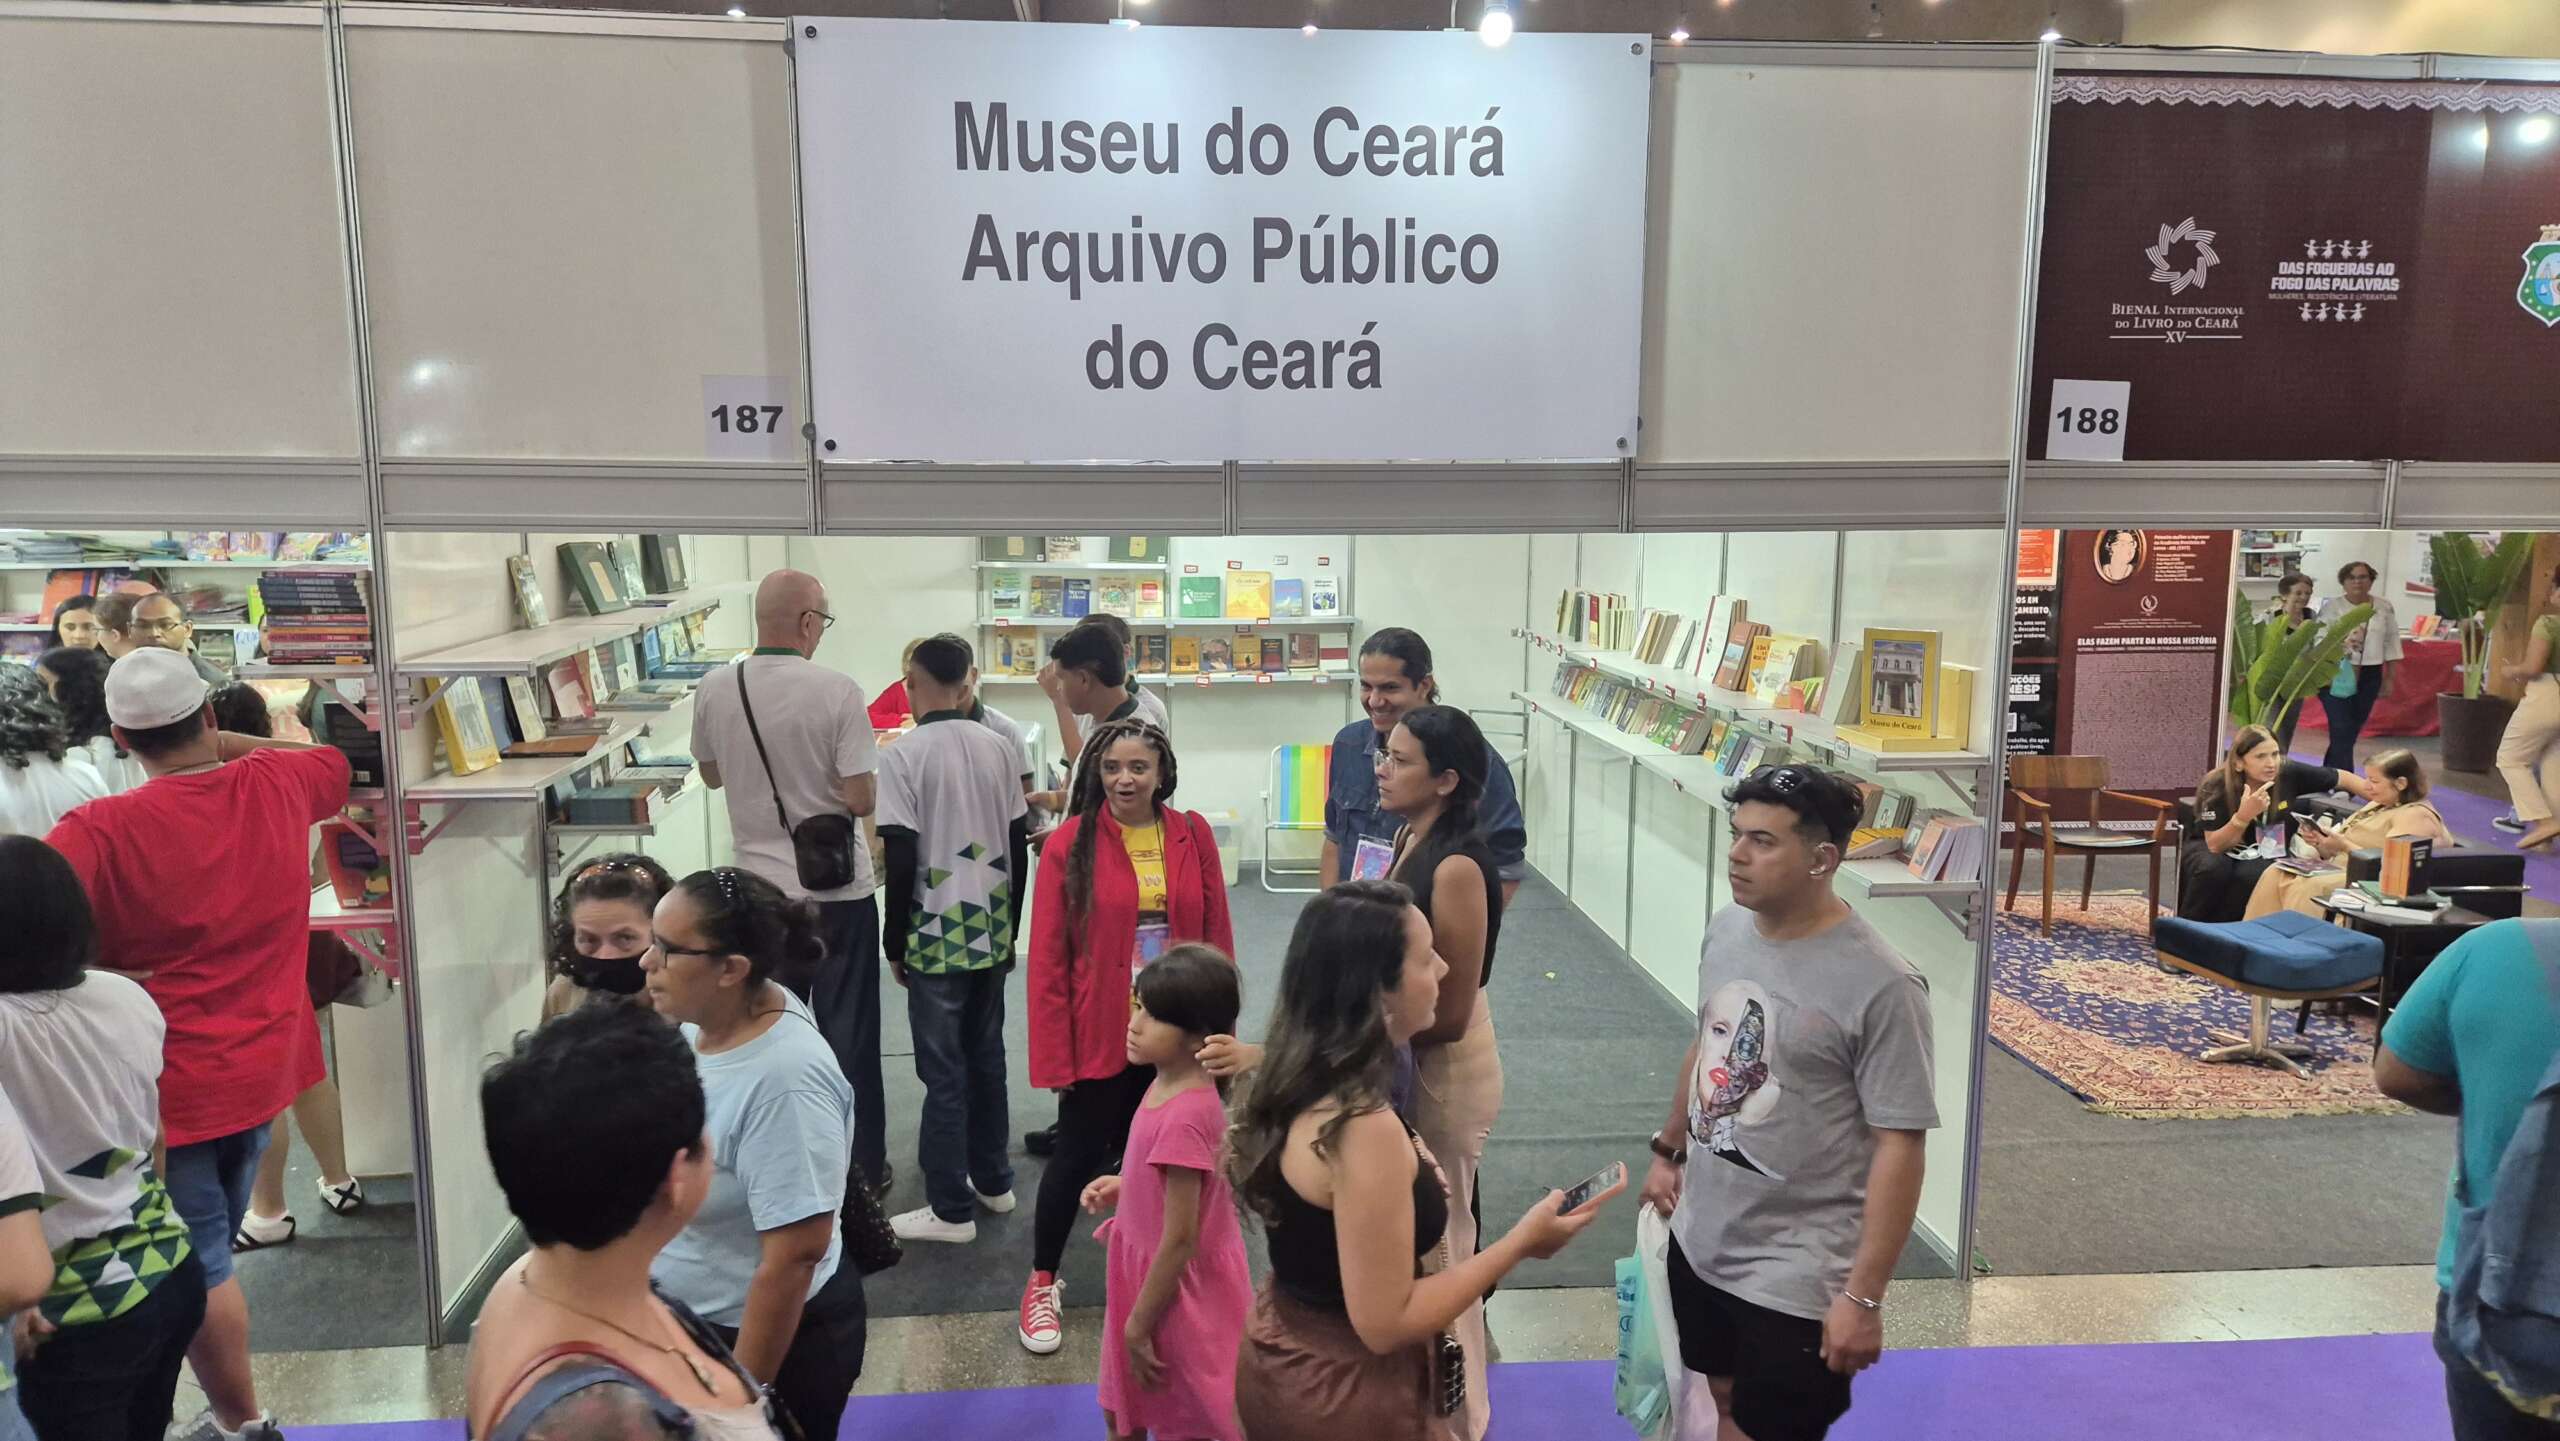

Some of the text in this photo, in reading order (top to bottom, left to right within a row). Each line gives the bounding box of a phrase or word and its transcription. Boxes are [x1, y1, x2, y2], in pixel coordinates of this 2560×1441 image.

[955, 102, 1503, 177] Museu do Ceará
[962, 214, 1498, 300] Arquivo Público
[2279, 262, 2395, 276] DAS FOGUEIRAS AO
[2271, 277, 2400, 291] FOGO DAS PALAVRAS
[2112, 303, 2160, 315] BIENAL
[2165, 331, 2186, 343] XV
[1086, 322, 1382, 390] do Ceará
[712, 405, 783, 433] 187
[2057, 407, 2119, 434] 188
[2077, 635, 2217, 646] ELAS FAZEM PARTE DA NOSSA HISTÓRIA
